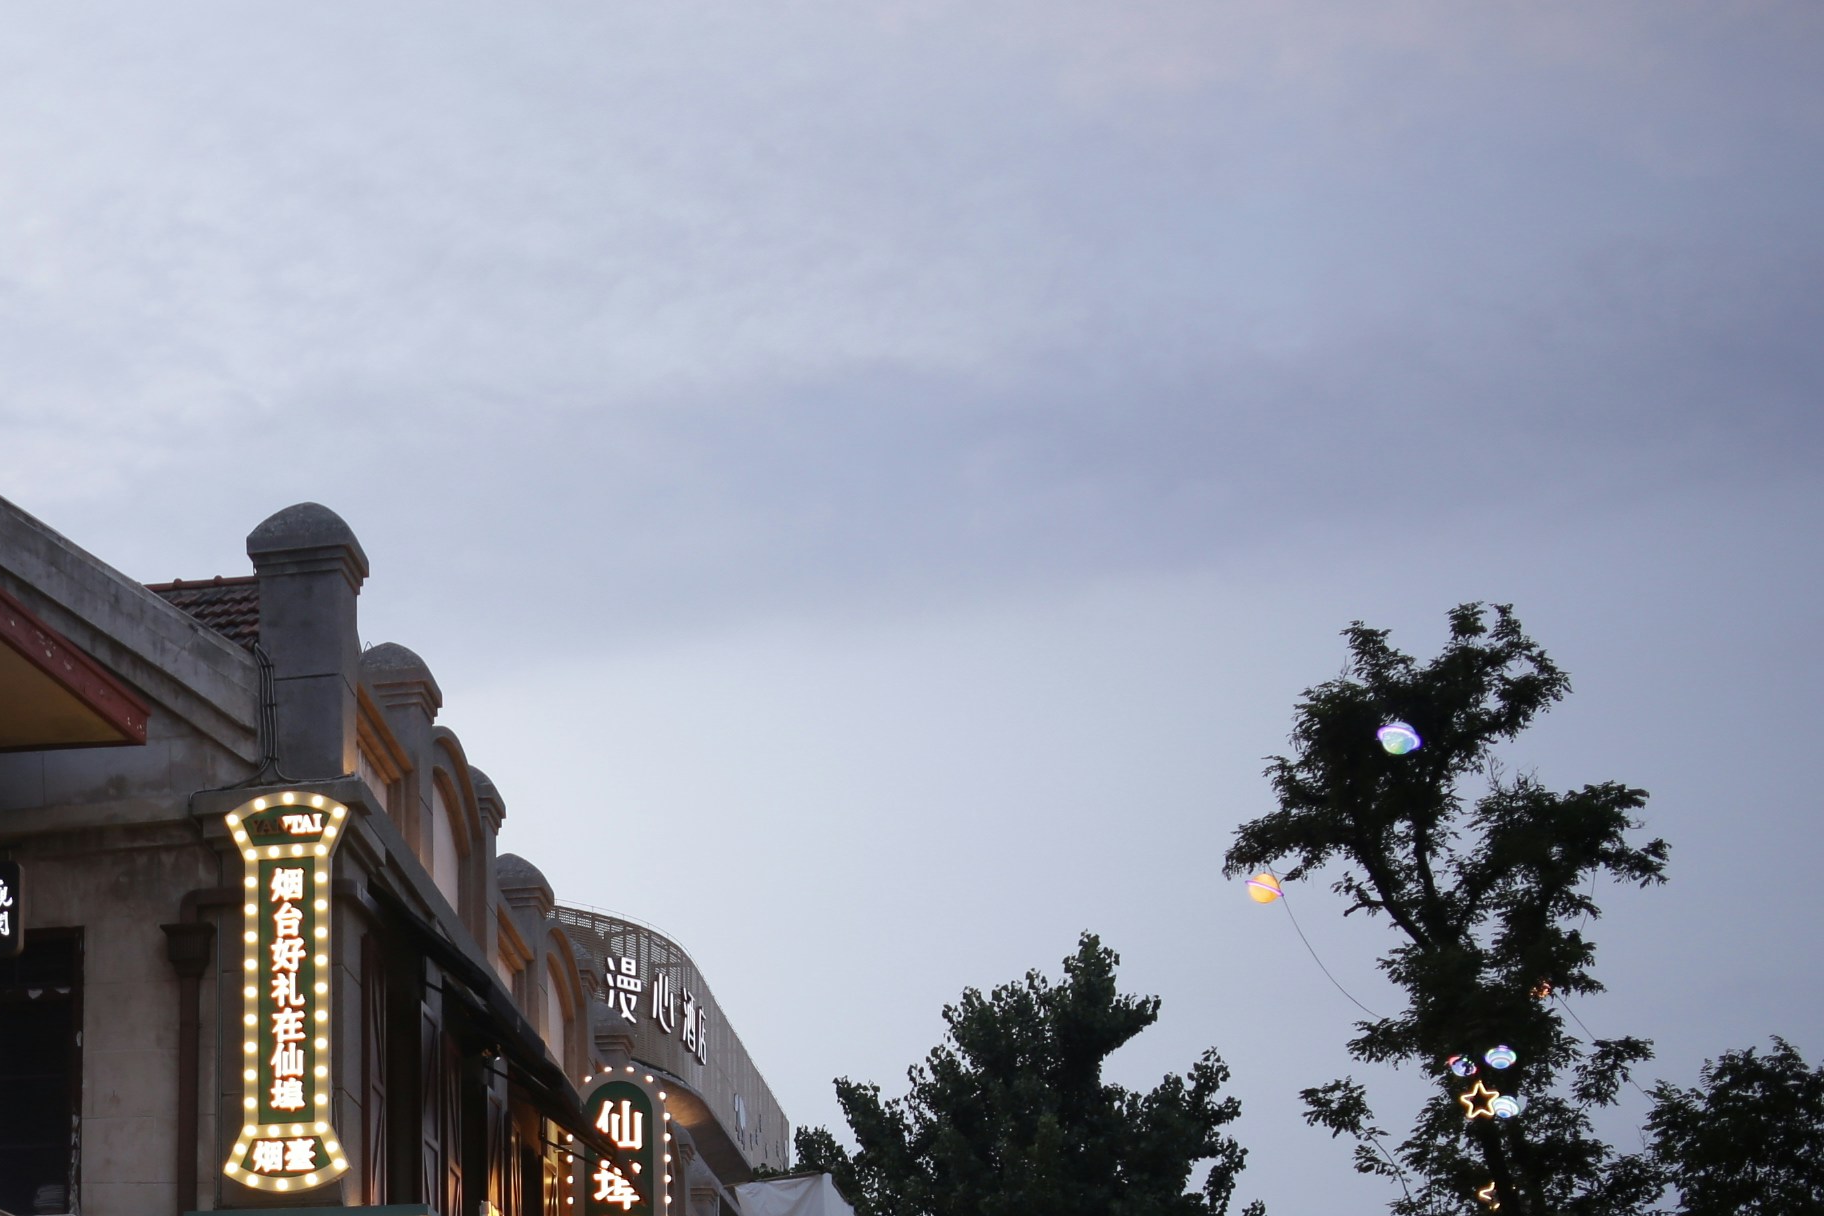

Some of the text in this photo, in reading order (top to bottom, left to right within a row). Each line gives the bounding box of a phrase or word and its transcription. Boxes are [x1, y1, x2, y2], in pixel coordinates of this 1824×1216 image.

[269, 866, 306, 1112] 烟台好礼在仙埠
[606, 957, 707, 1065] 漫心酒店
